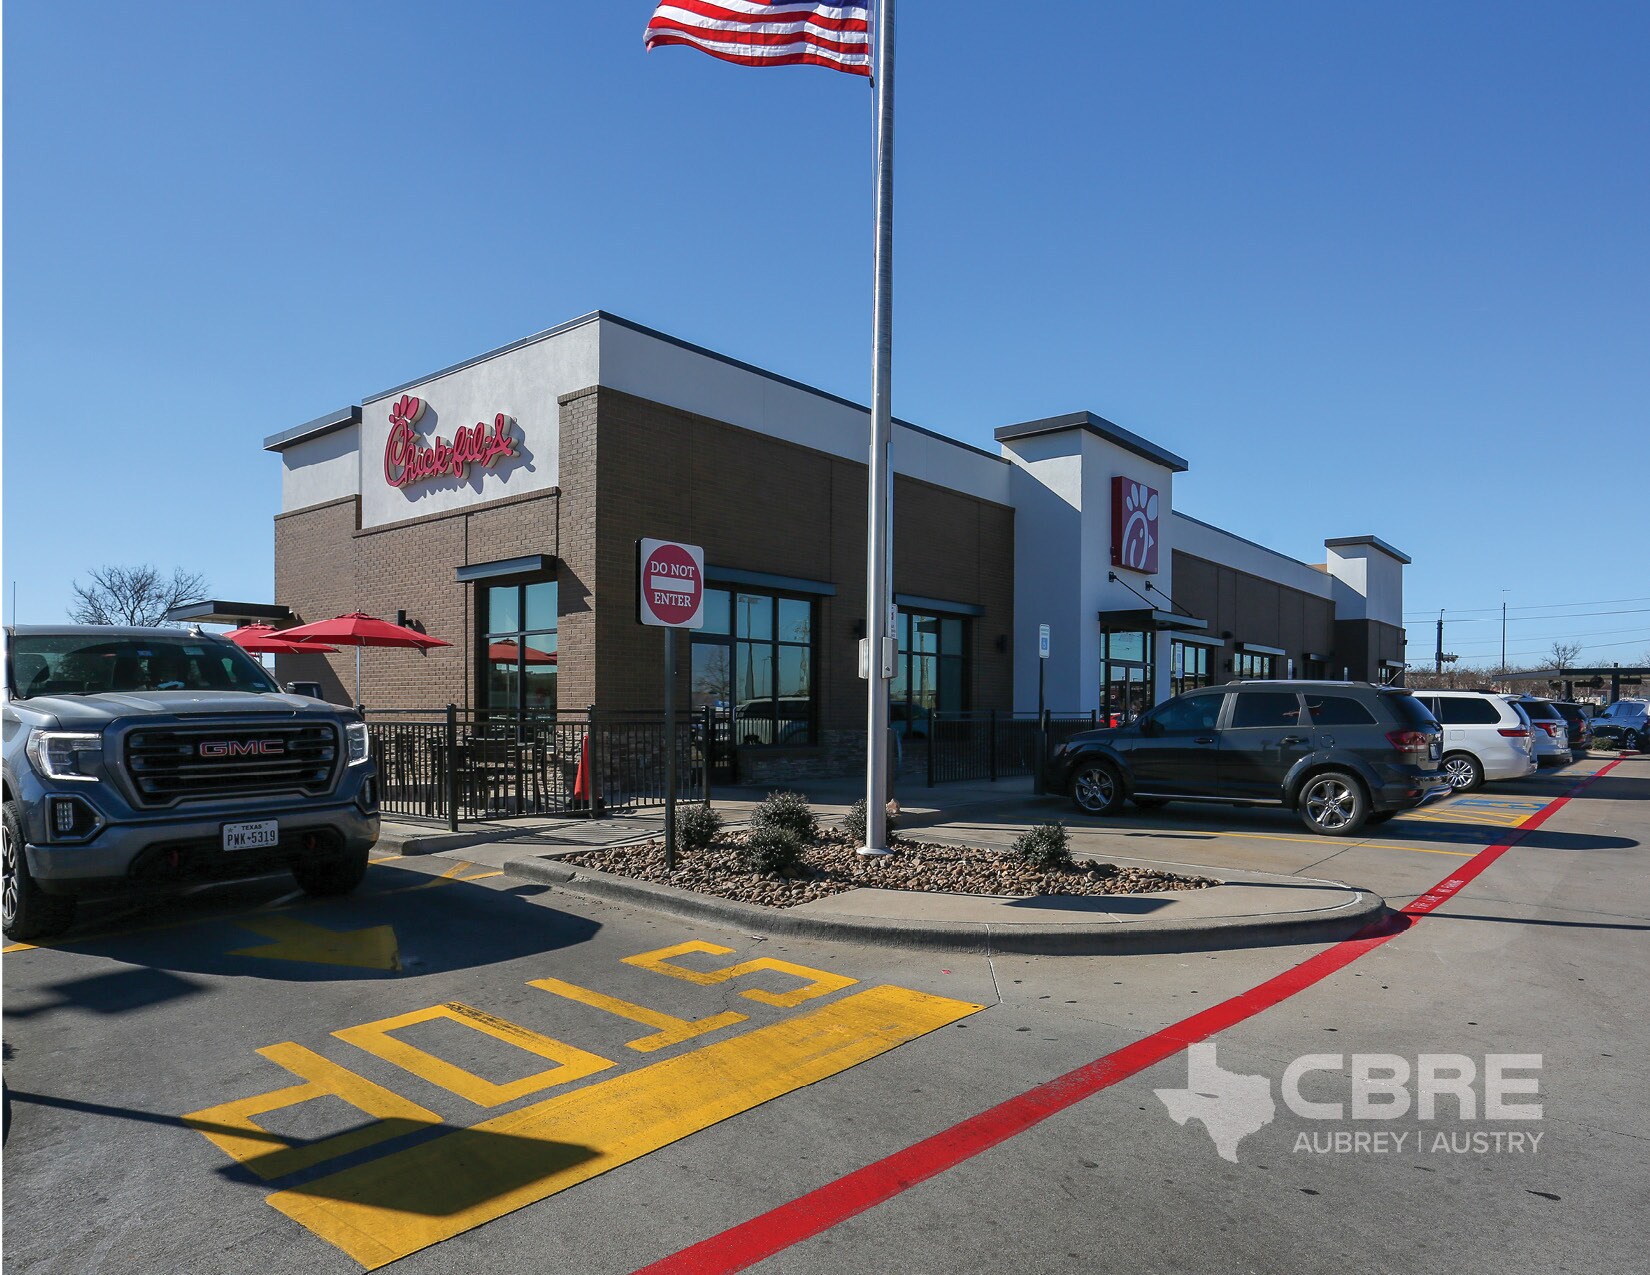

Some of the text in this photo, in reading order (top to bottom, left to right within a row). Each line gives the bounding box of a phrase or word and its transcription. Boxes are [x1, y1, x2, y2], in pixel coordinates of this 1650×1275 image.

[384, 395, 513, 487] Chick-fil-A
[651, 561, 694, 578] DO NOT
[654, 592, 692, 607] ENTER
[200, 740, 284, 757] GMC
[182, 940, 859, 1181] STOP
